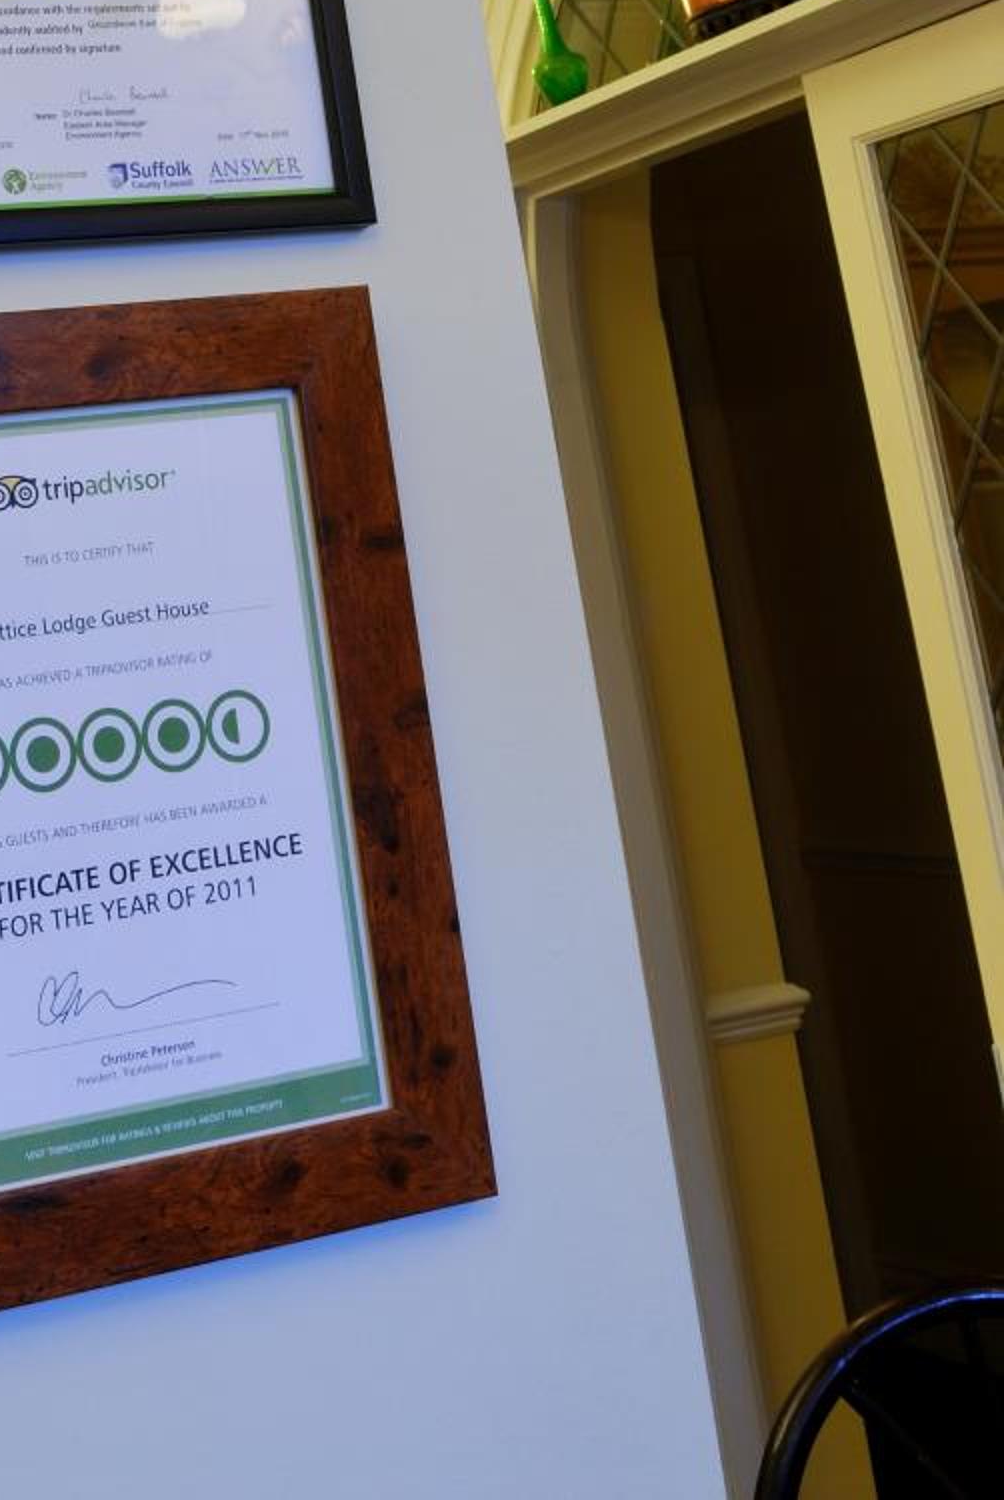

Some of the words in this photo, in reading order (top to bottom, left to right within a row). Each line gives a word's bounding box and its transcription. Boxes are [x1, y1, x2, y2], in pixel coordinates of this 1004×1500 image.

[131, 161, 192, 179] Suffolk
[211, 157, 302, 177] ANSWER
[43, 468, 169, 504] tripadvisor
[24, 554, 49, 567] THIS
[51, 552, 61, 564] IS
[65, 551, 79, 563] TO
[82, 545, 122, 562] CERTIFY
[126, 541, 154, 555] THAT
[42, 614, 96, 636] Lodge
[101, 608, 151, 628] Guest
[156, 600, 209, 621] House
[16, 669, 70, 688] ACHIEVED
[75, 669, 83, 679] A
[87, 656, 154, 677] TRIPADVISOR
[157, 652, 193, 668] RATING
[198, 650, 212, 663] OF
[5, 830, 48, 848] GUESTS
[52, 825, 77, 839] AND
[81, 815, 140, 835] THEREFORE
[144, 811, 167, 824] HAS
[169, 806, 196, 822] BEEN
[200, 798, 256, 816] AWARDED
[259, 797, 267, 806] A
[109, 860, 141, 885] OF
[150, 833, 303, 879] EXCELLENCE
[51, 903, 94, 931] THE
[100, 893, 160, 922] YEAR
[168, 886, 196, 910] OF
[204, 876, 257, 905] 2011
[101, 1049, 149, 1067] Christine
[150, 1040, 196, 1057] Peterson
